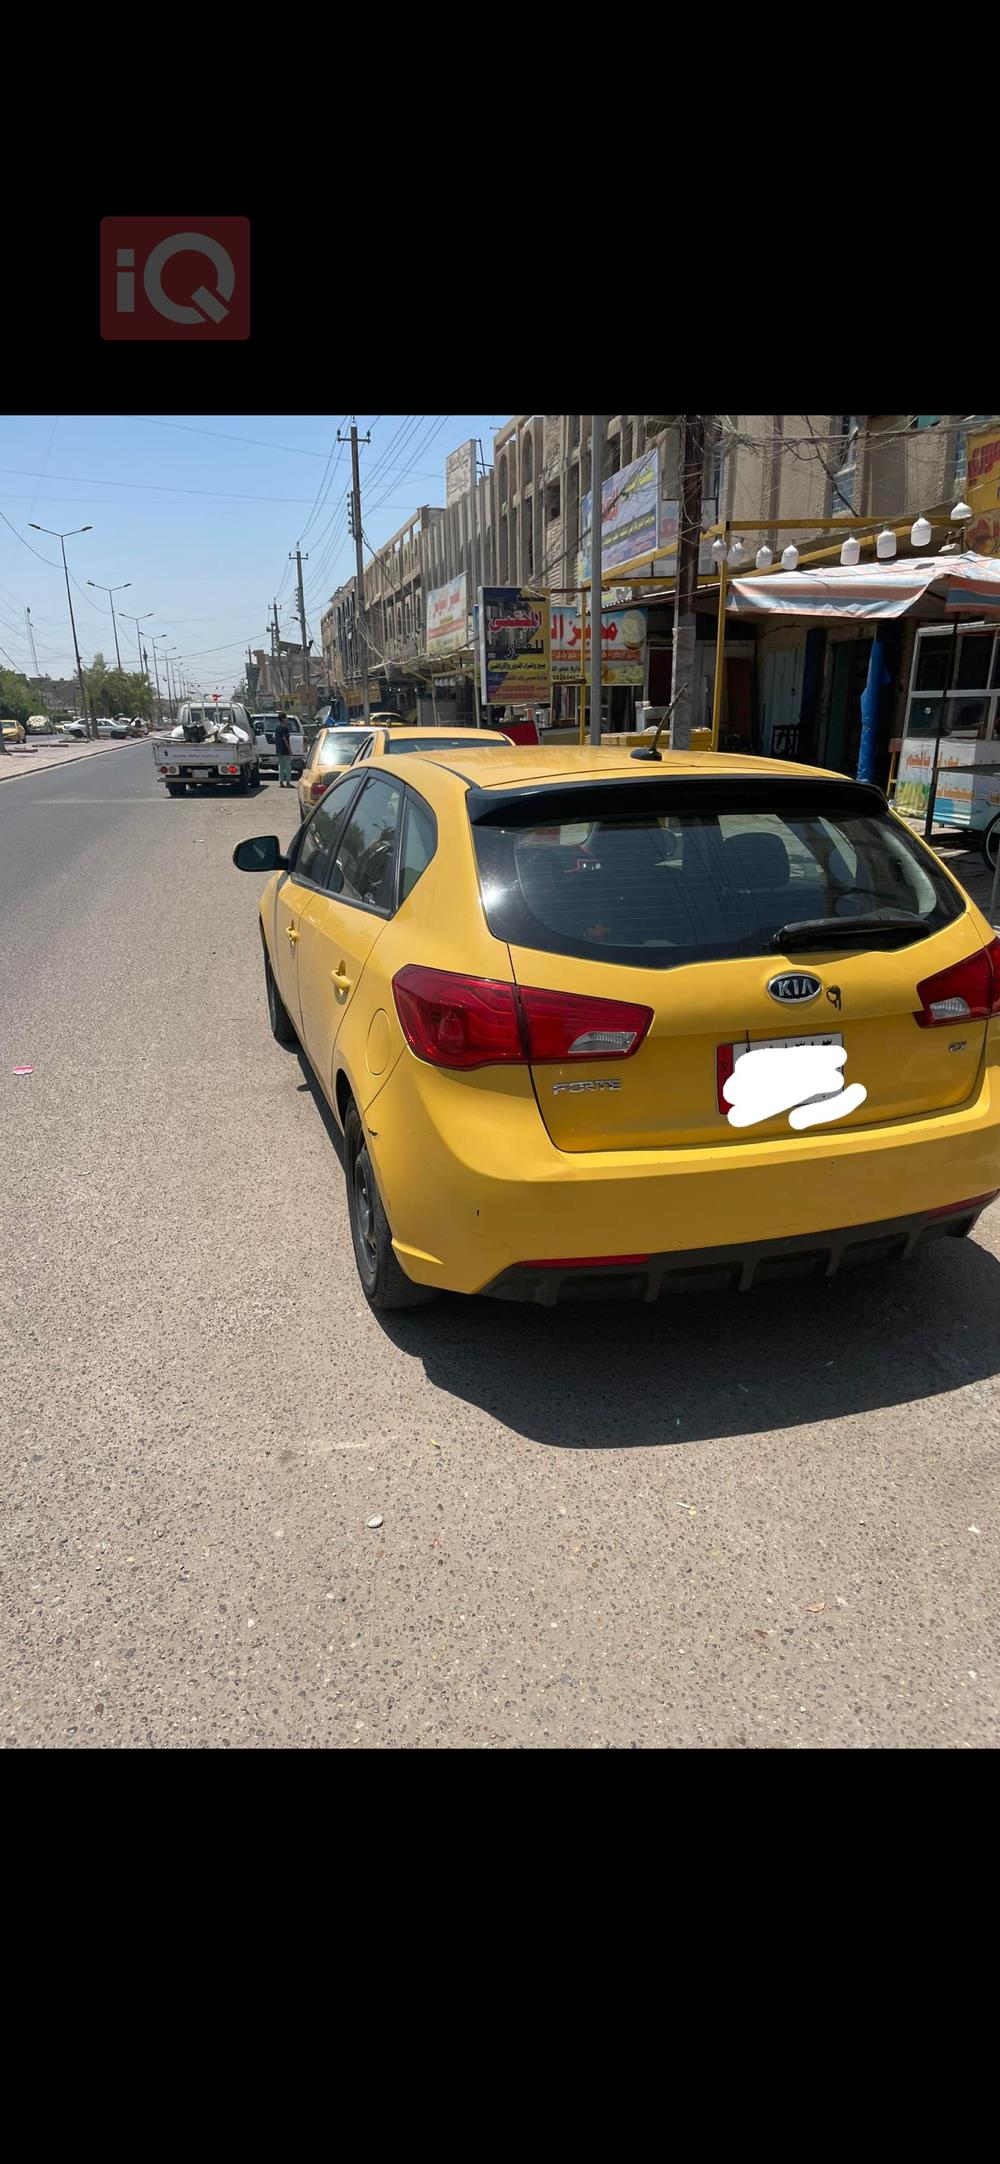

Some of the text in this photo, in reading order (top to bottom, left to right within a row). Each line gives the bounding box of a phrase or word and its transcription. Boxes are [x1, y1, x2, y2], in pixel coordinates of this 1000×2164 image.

[568, 620, 617, 646] مبز
[777, 979, 814, 997] KIA
[552, 1079, 622, 1094] FORTE
